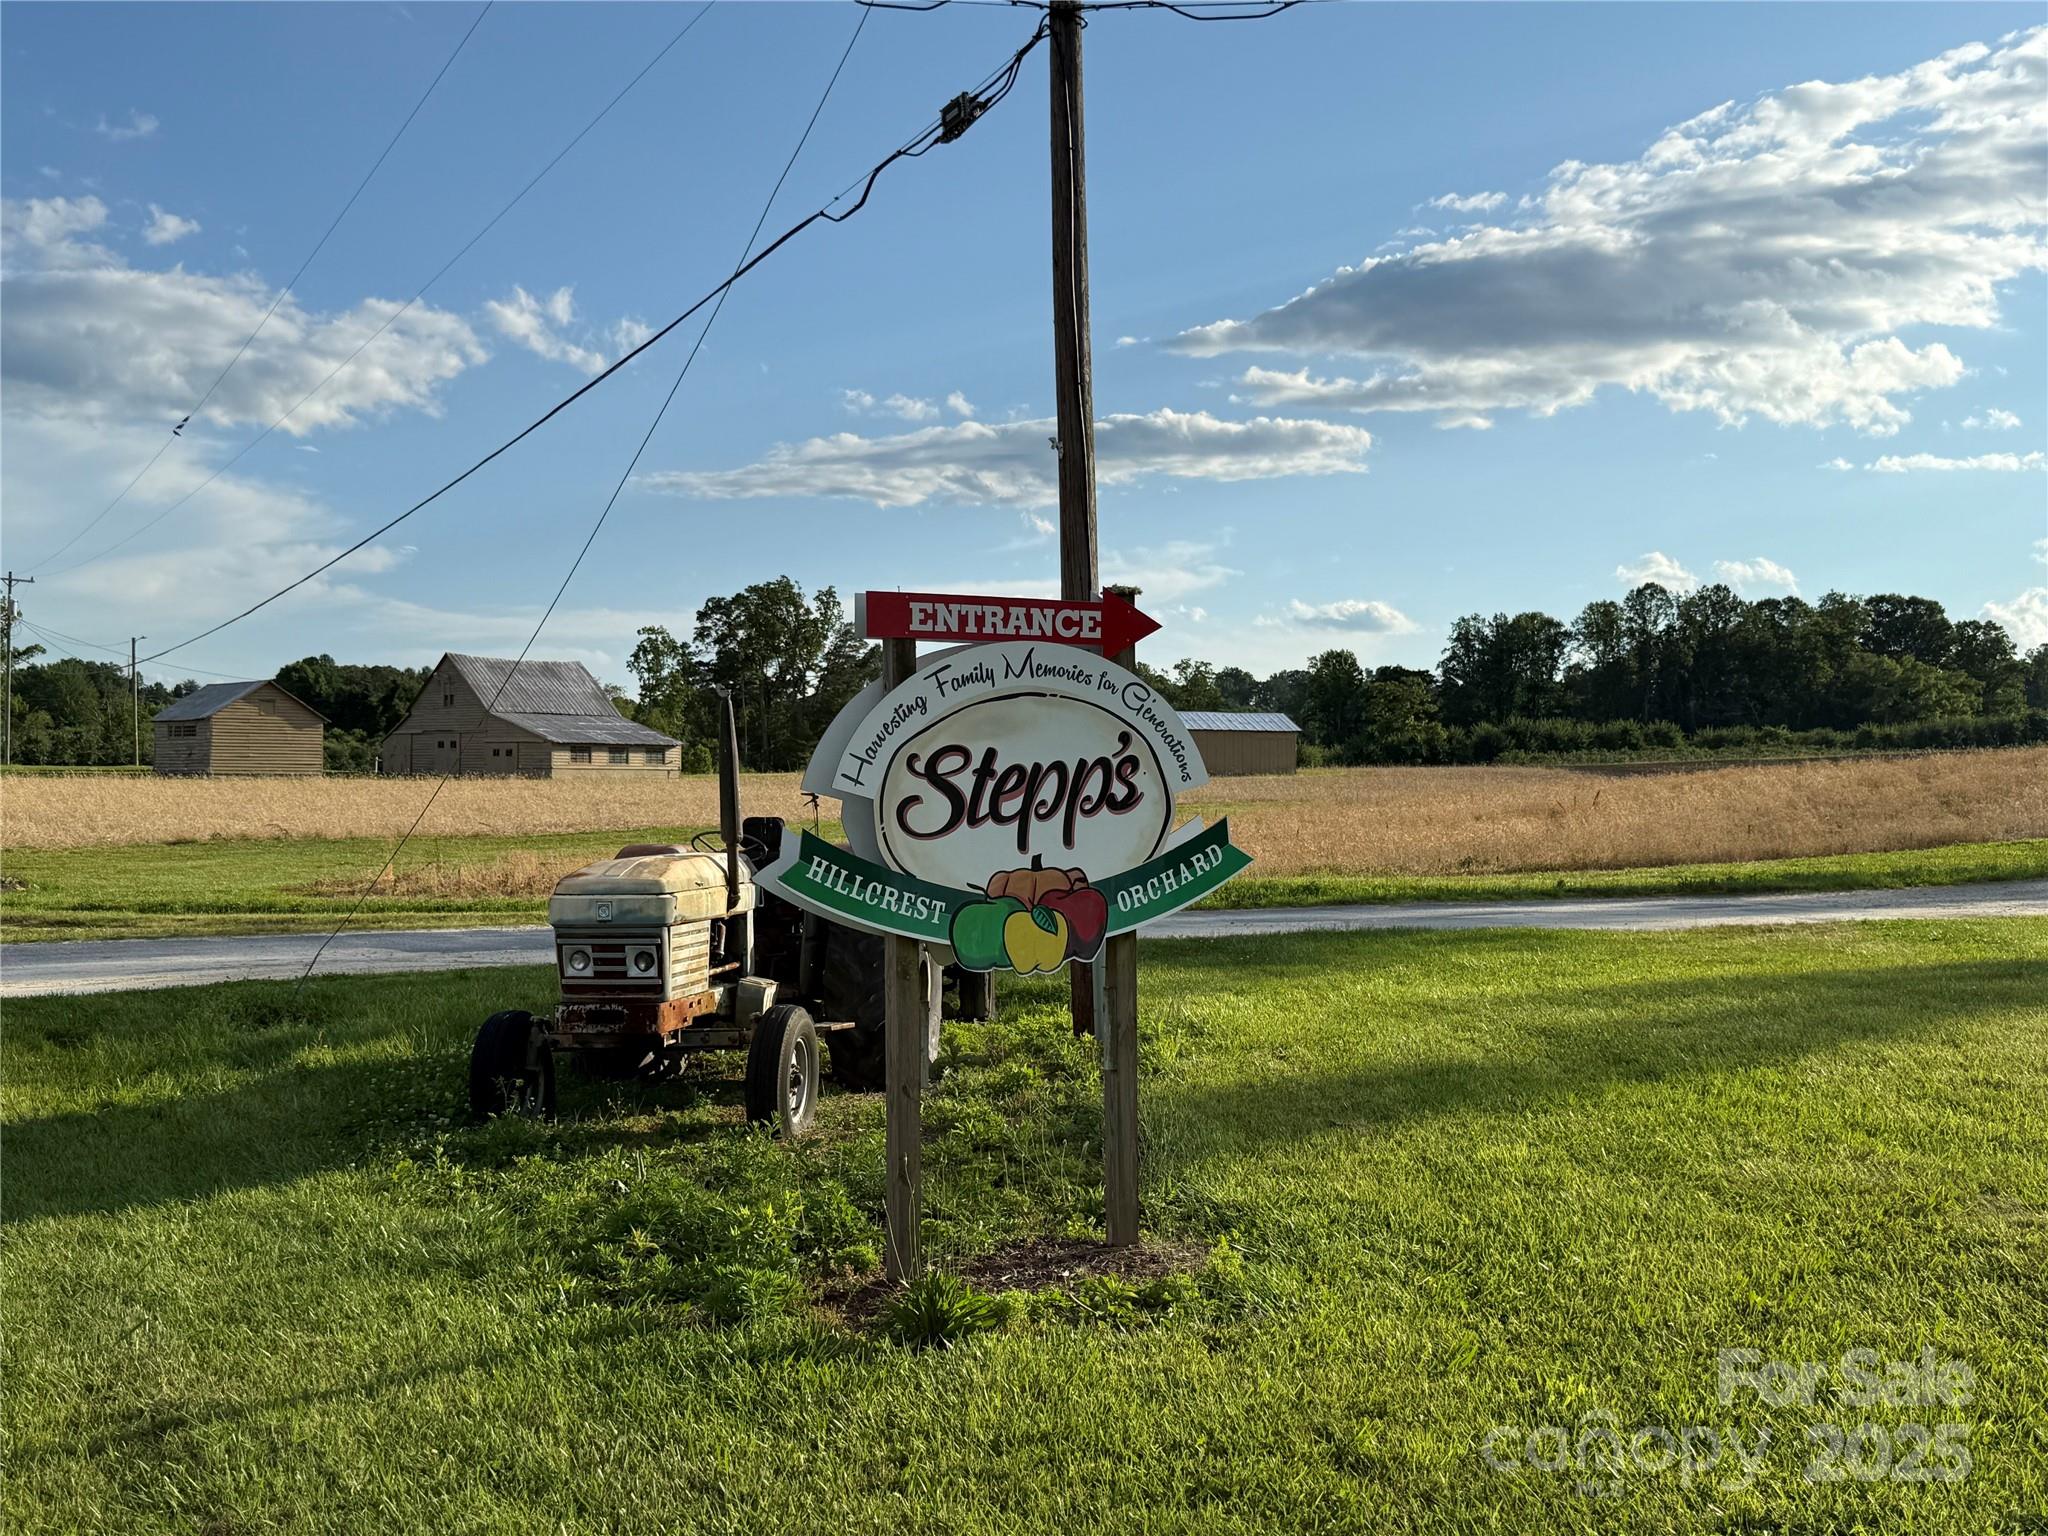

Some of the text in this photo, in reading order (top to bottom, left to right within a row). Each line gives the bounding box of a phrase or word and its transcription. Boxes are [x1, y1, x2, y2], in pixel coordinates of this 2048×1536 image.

[909, 601, 1102, 639] ENTRANCE
[840, 647, 1192, 788] Harvesting Family Memories for Generations
[896, 730, 1145, 855] Stepp's
[805, 855, 946, 925] HILLCREST
[1117, 843, 1224, 913] ORCHARD
